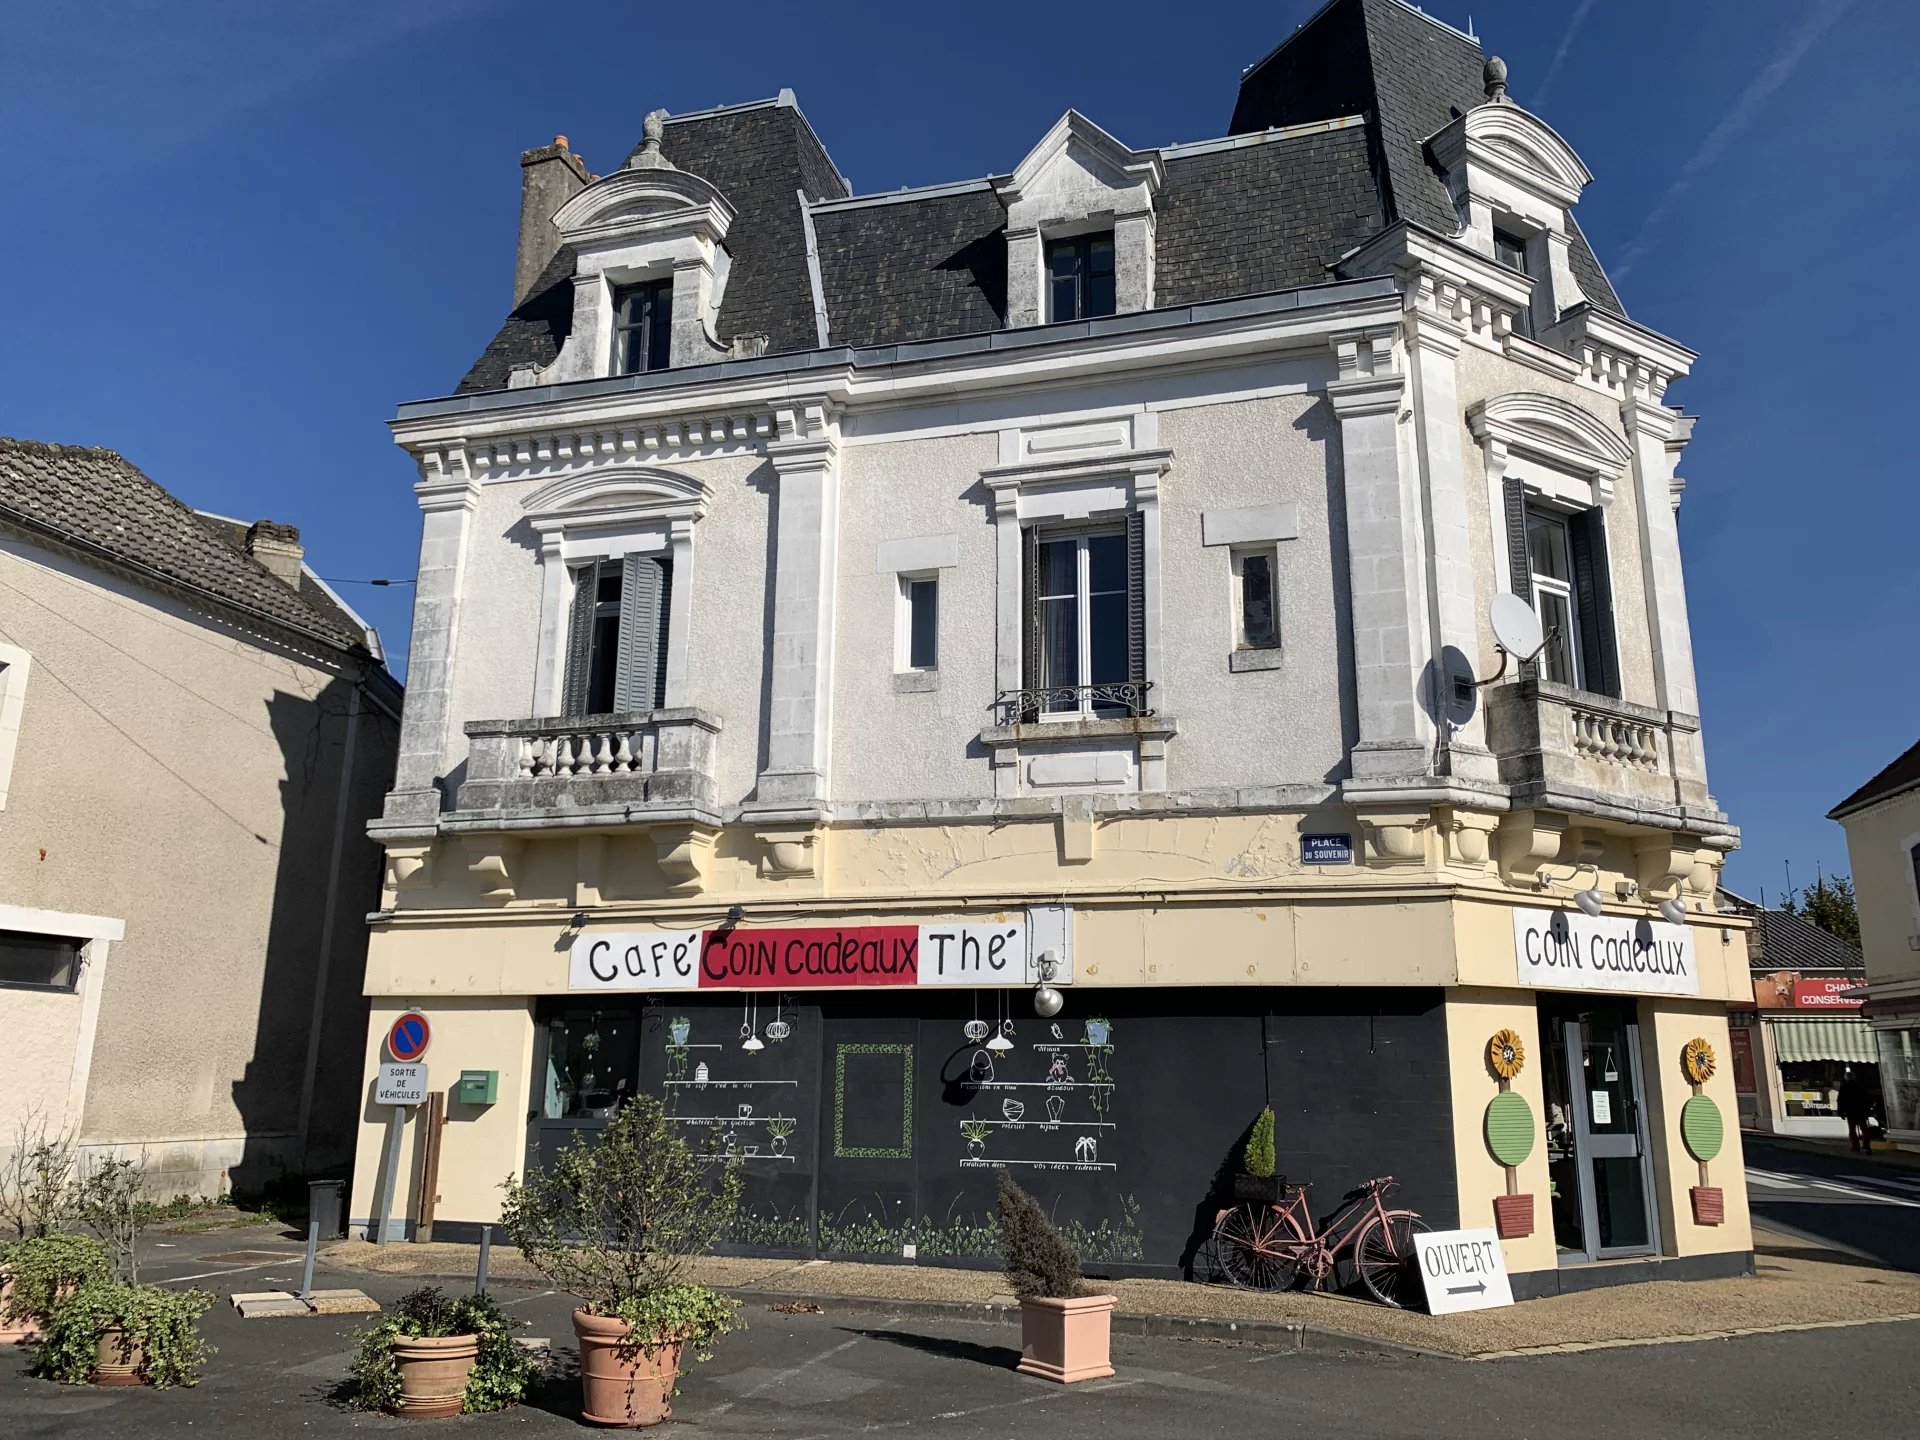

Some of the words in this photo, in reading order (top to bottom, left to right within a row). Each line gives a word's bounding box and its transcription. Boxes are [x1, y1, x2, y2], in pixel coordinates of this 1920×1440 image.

[1311, 838, 1342, 847] PLACE
[1305, 851, 1313, 860] DU
[1314, 849, 1349, 859] SOUVENIR
[928, 927, 1017, 976] Thé
[390, 1068, 417, 1077] SORTIE
[396, 1079, 406, 1088] DE
[380, 1089, 421, 1099] VÉHICULES
[1074, 1164, 1102, 1172] cadeaux
[1424, 1240, 1495, 1278] OUVERT
